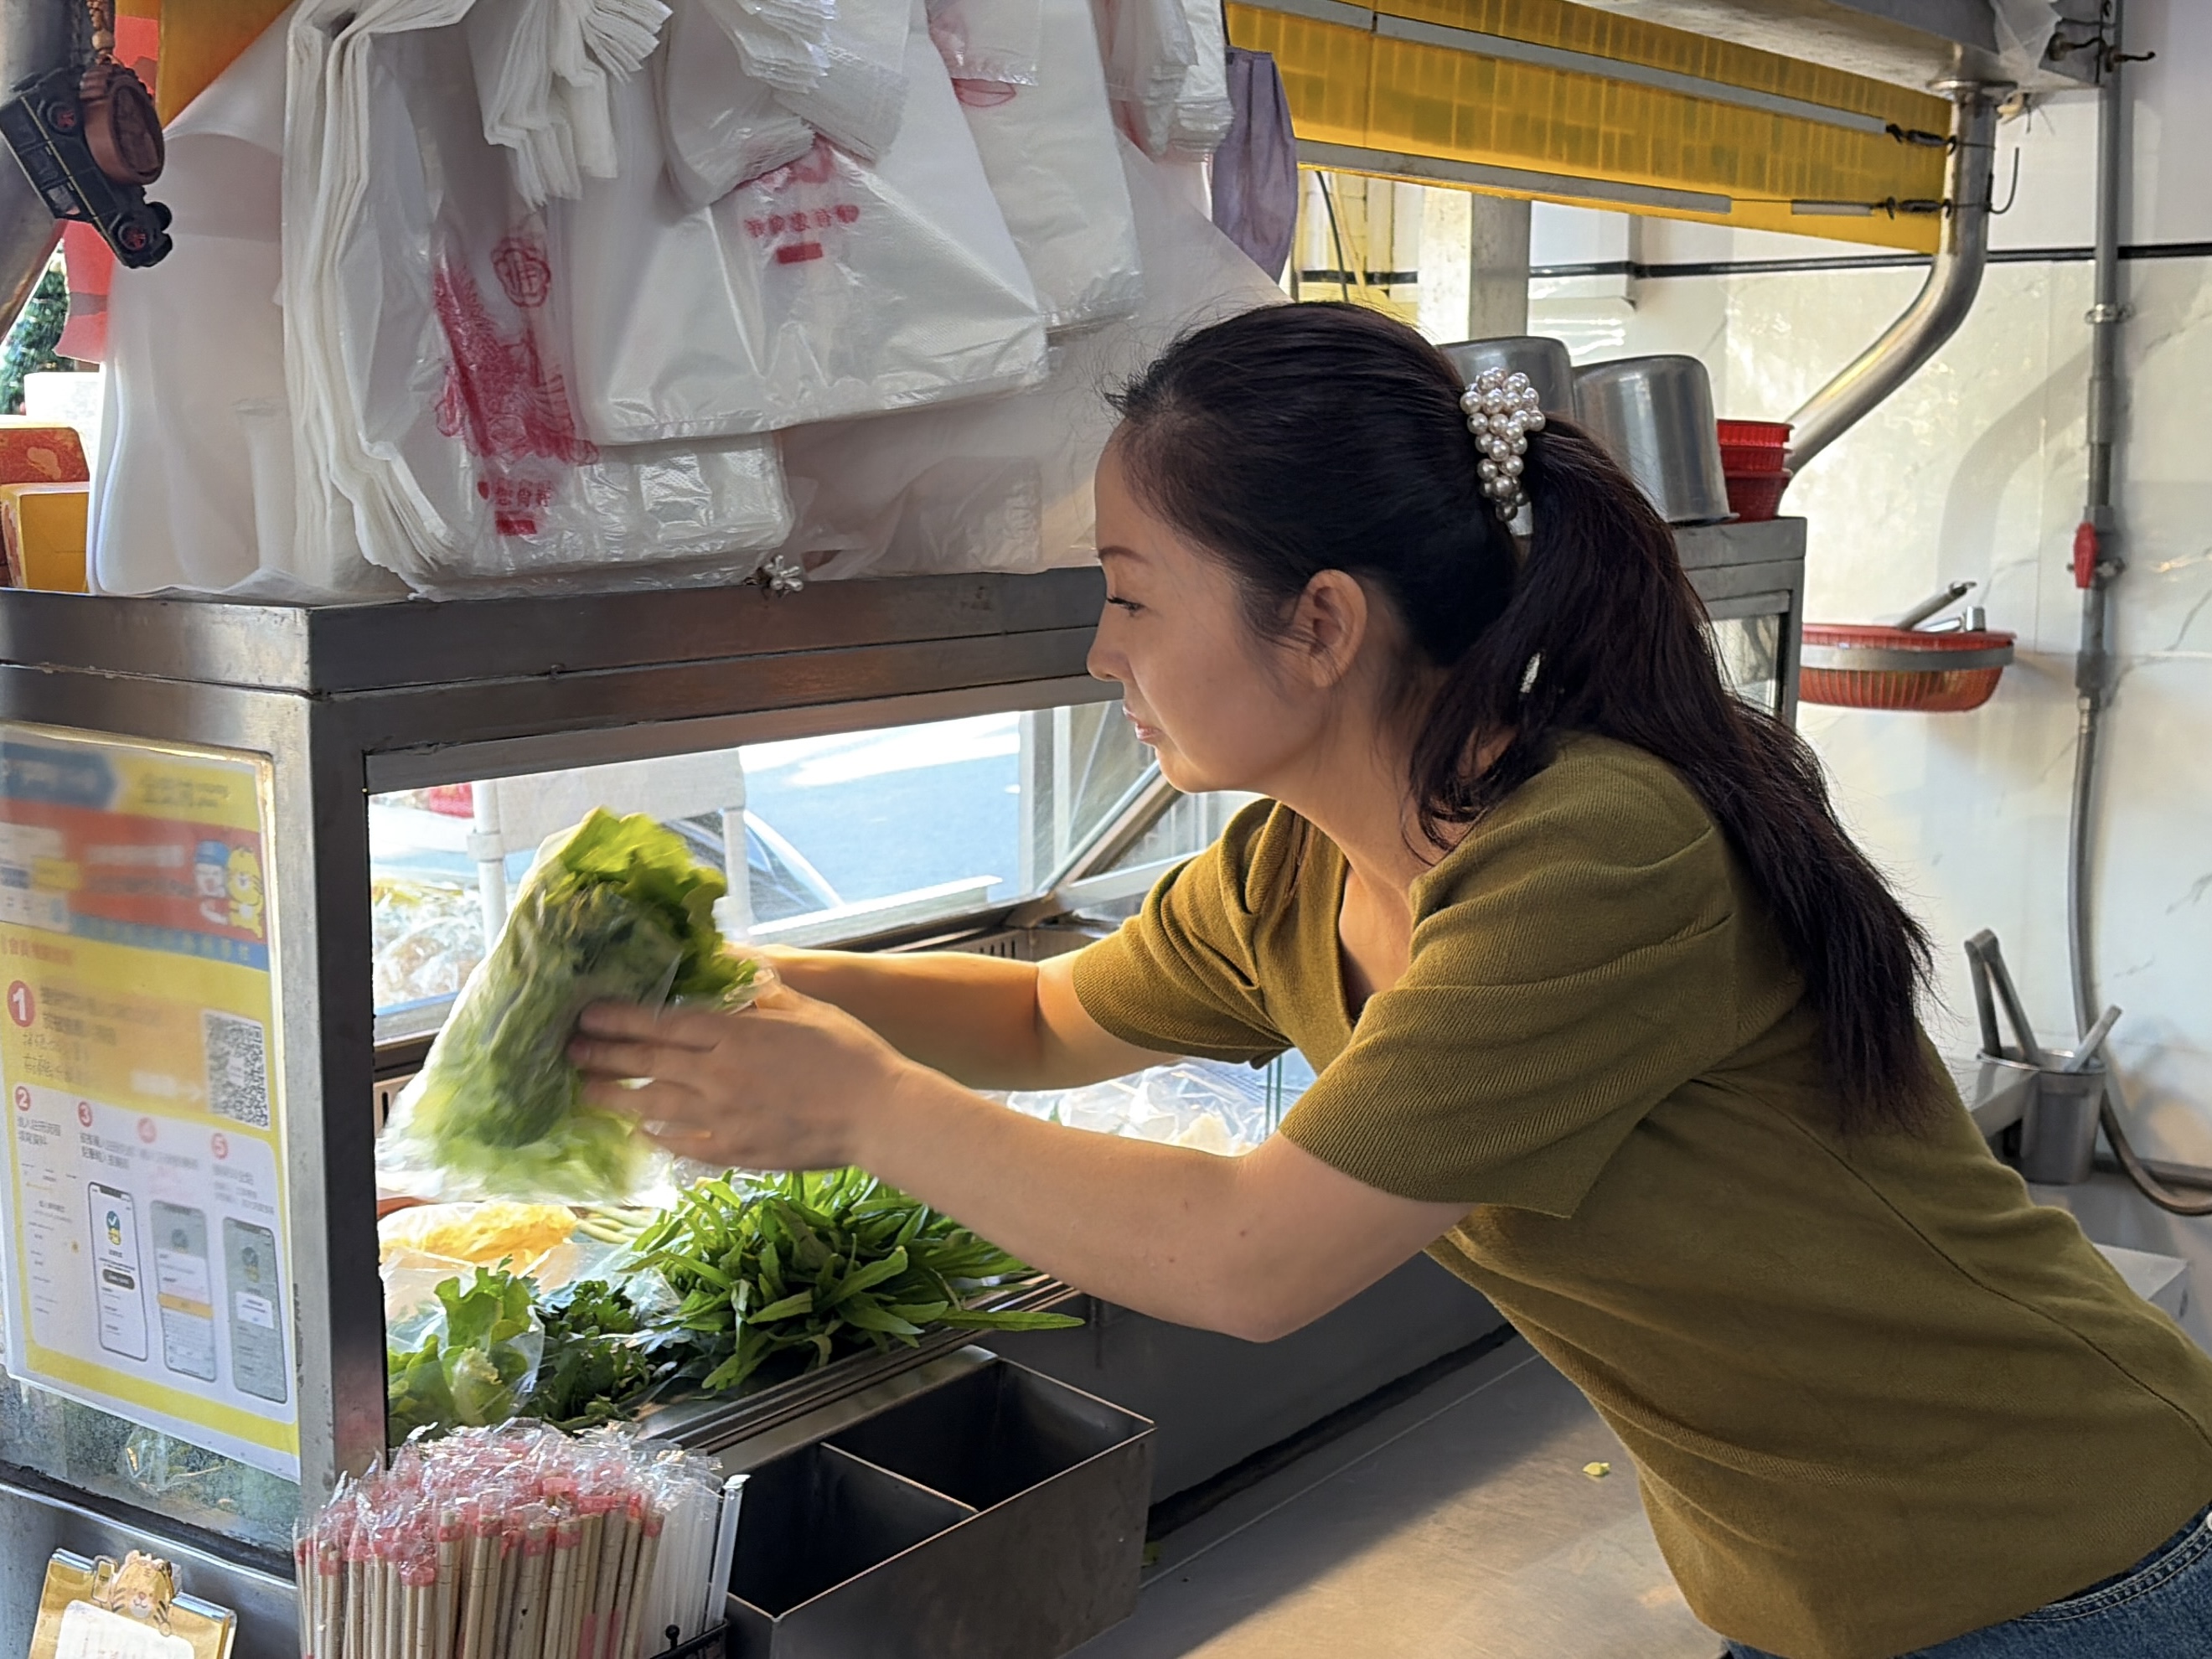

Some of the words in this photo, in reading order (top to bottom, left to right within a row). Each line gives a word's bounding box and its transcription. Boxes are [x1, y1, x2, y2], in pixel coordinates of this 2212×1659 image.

[13, 988, 26, 1021] 1
[18, 1088, 28, 1107] 2
[80, 1104, 90, 1124] 3
